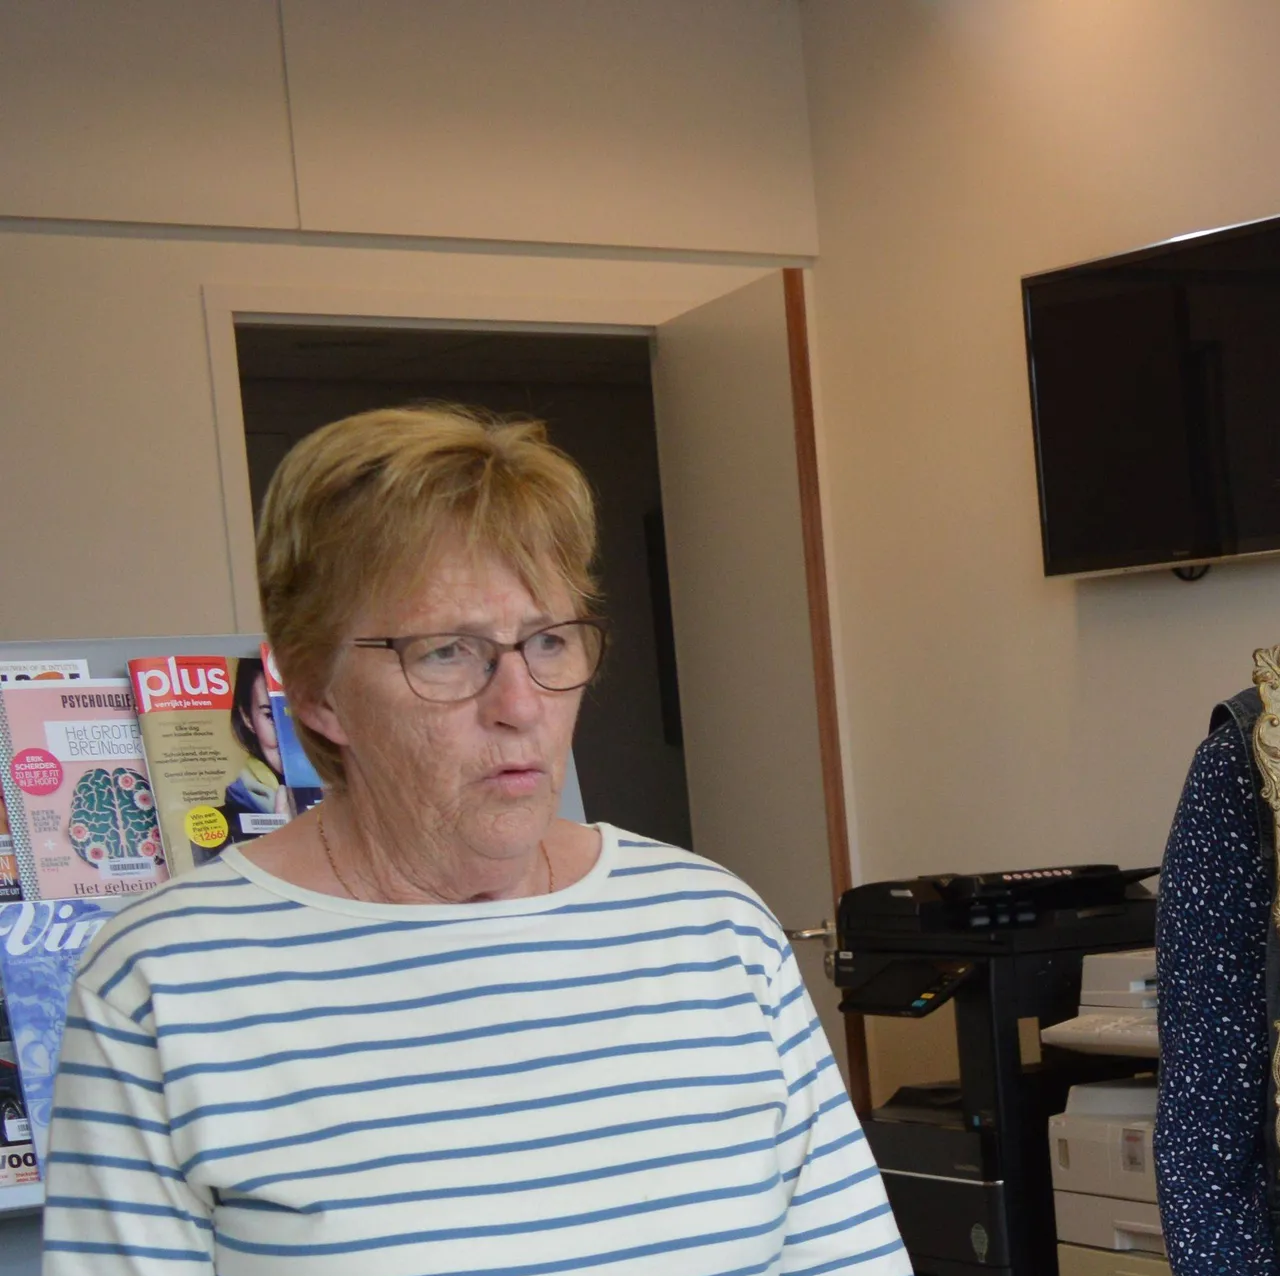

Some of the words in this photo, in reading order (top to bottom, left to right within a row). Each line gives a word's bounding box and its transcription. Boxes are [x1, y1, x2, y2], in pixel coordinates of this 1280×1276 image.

[137, 656, 230, 714] plus
[61, 694, 131, 709] PSYCHOLOGIE
[154, 699, 183, 708] verrijkt
[183, 699, 191, 708] je
[191, 698, 212, 706] leven
[65, 726, 90, 741] Het
[92, 724, 139, 740] GROTE
[69, 740, 141, 756] BREINboek
[74, 883, 99, 895] Het
[105, 879, 157, 895] geheim
